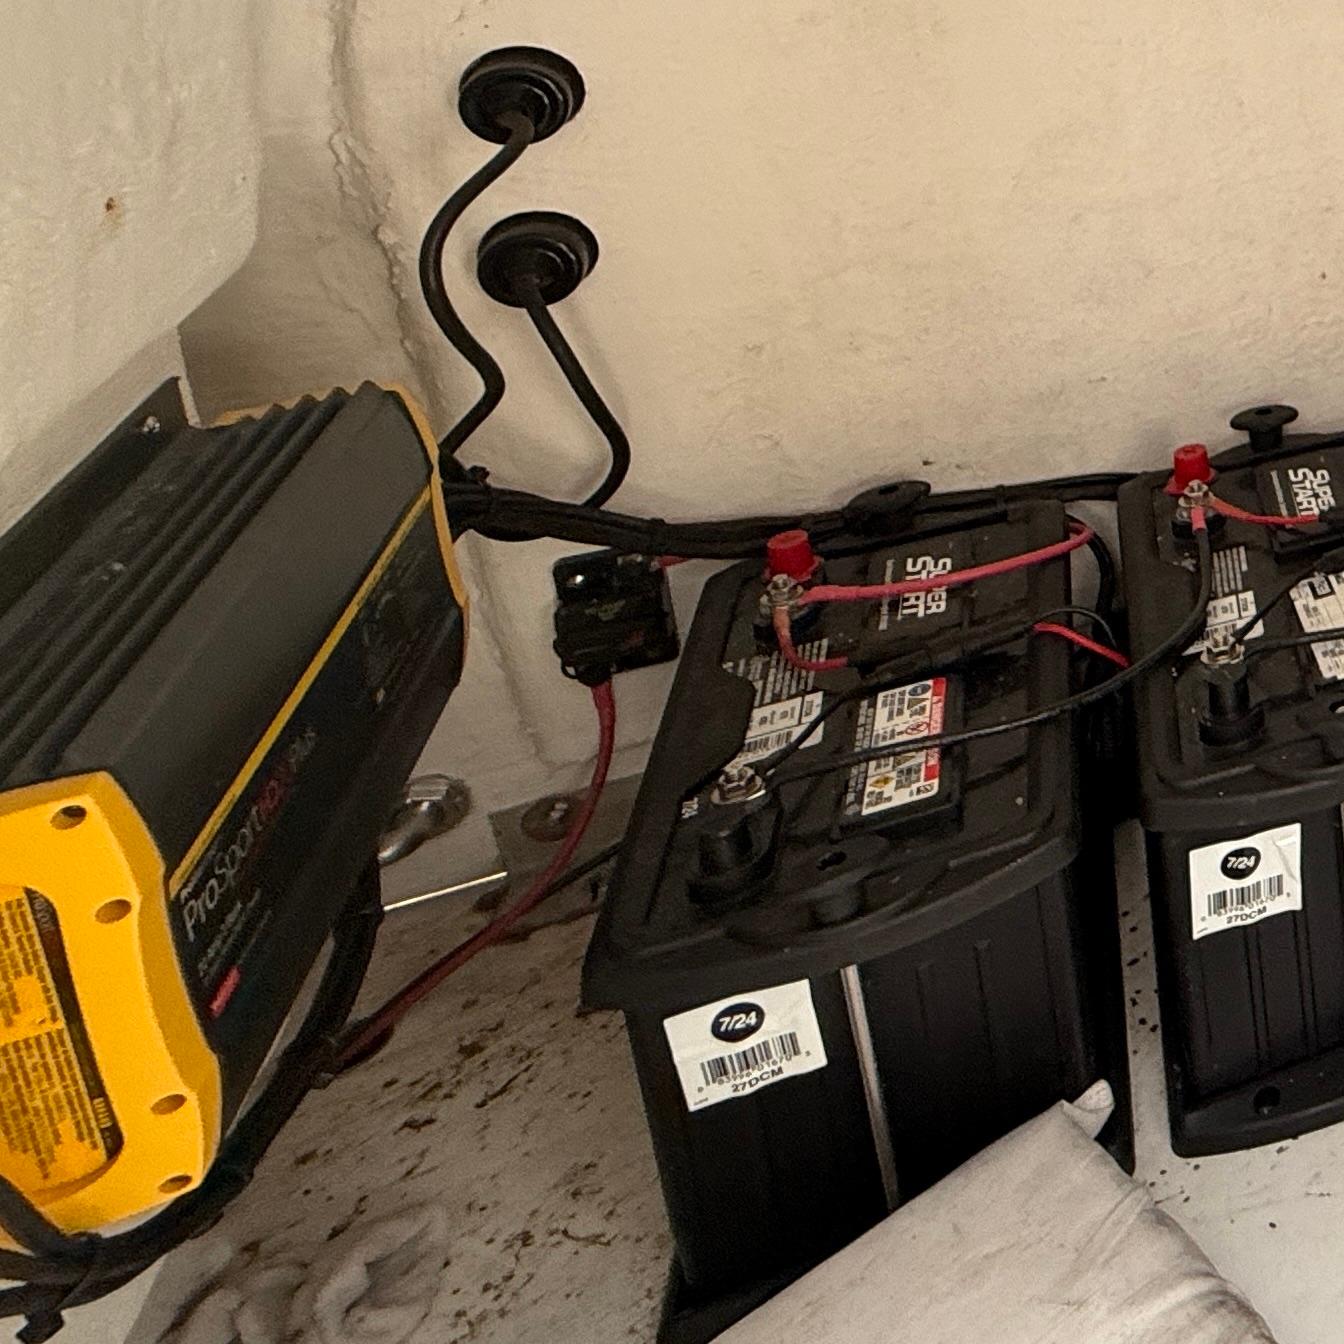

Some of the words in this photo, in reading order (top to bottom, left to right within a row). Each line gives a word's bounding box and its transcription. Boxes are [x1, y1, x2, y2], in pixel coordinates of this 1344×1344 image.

[1288, 468, 1320, 518] START
[1227, 855, 1256, 870] 7/24
[1226, 905, 1267, 925] 27DCM
[718, 1011, 759, 1032] 7/24
[732, 1067, 784, 1093] 27DCM
